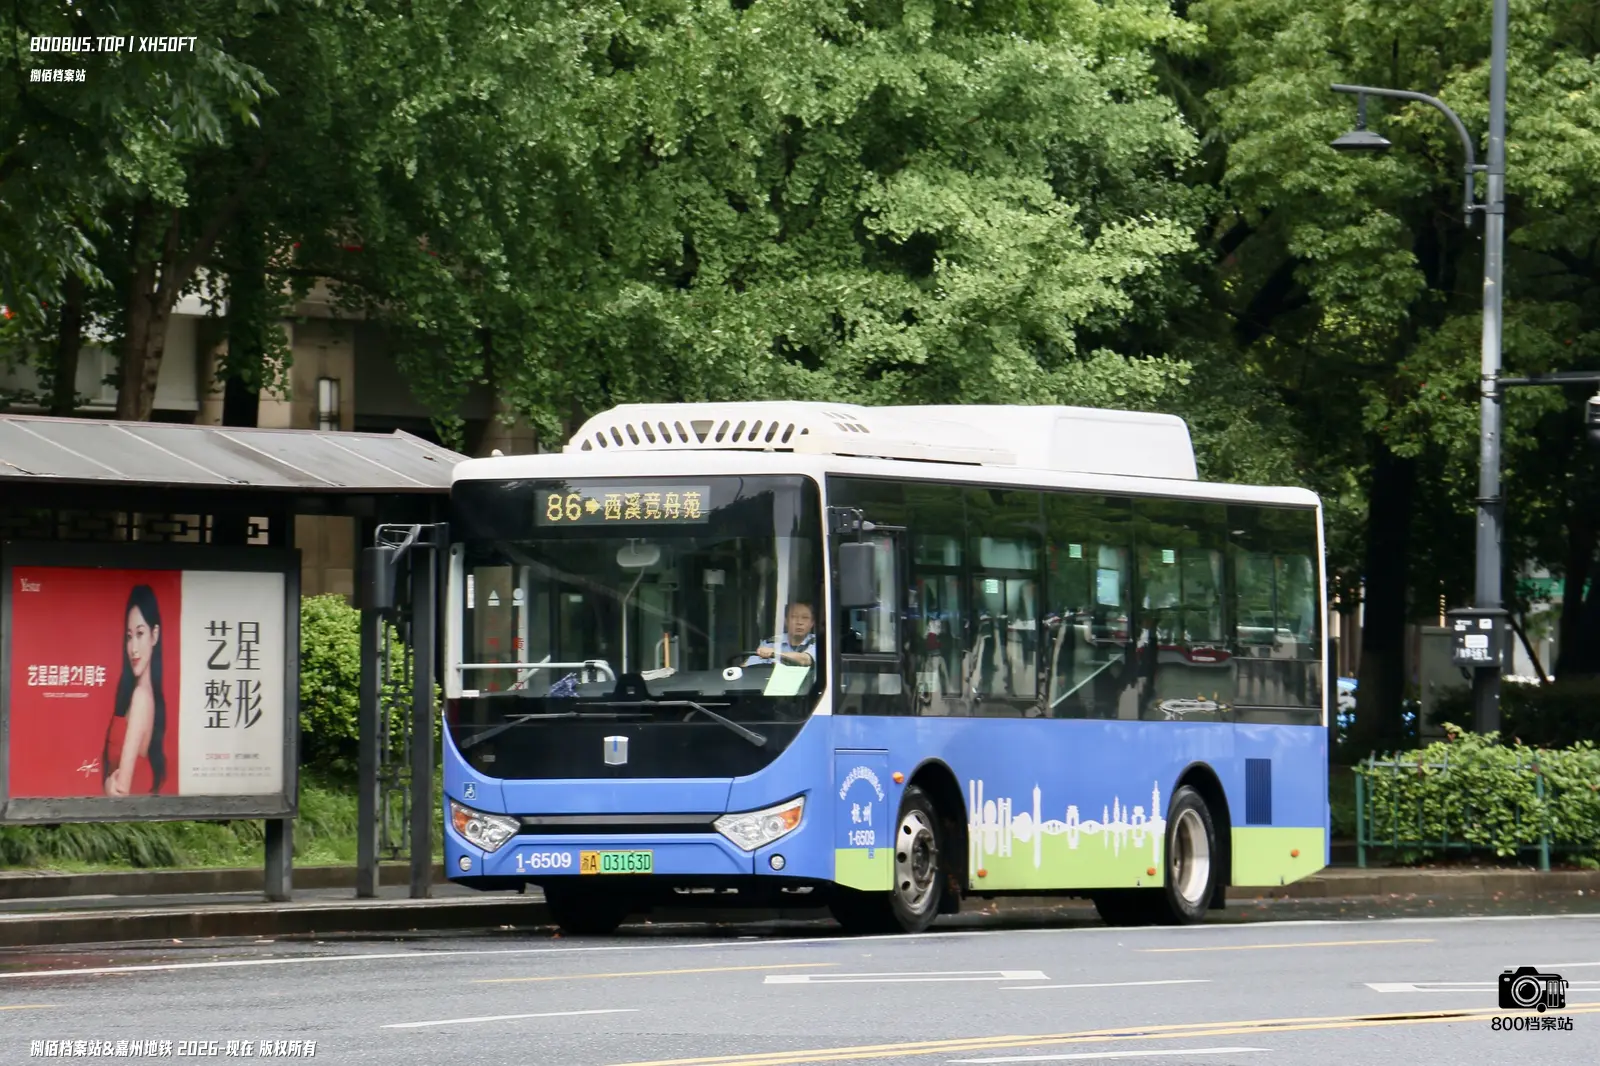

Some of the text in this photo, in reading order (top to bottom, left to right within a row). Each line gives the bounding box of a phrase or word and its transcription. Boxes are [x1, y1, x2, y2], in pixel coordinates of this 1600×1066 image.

[546, 493, 582, 521] 86
[204, 620, 261, 671] 艺星
[27, 664, 107, 687] 艺星品牌21周年
[204, 679, 263, 729] 整形
[848, 830, 875, 845] 1-6509
[515, 852, 572, 868] 1-6509
